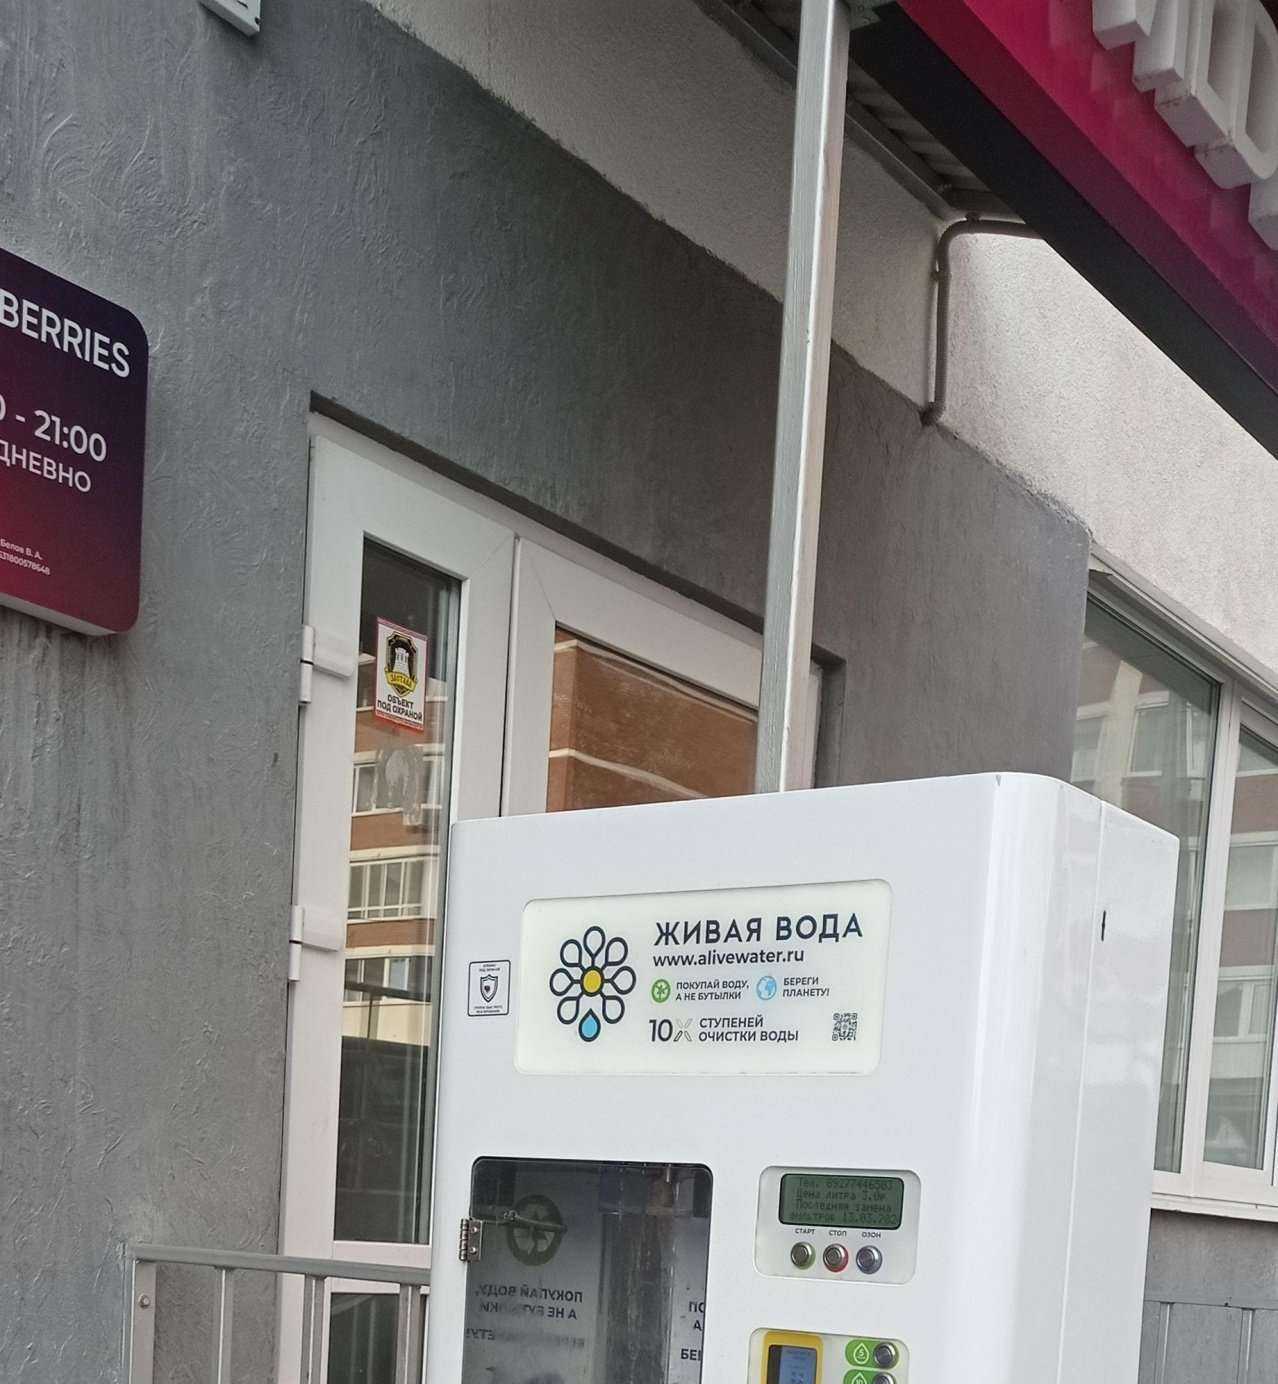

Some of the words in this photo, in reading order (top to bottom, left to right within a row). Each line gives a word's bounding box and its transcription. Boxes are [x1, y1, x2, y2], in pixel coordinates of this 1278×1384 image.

[0, 288, 130, 378] BERRIES
[34, 410, 107, 462] 21:00
[387, 694, 414, 709] ОБЪЕКТ
[377, 699, 392, 713] ПОД
[392, 705, 422, 720] ОХРАНОЙ
[654, 917, 762, 946] ЖИВАЯ
[775, 913, 863, 943] ВОДА
[653, 948, 804, 967] www.alivewater.ru
[676, 979, 720, 990] ПОКУПАЙ
[722, 979, 749, 989] ВОДУ,
[783, 977, 819, 986] БЕРЕГИ
[676, 993, 682, 1001] А
[684, 992, 696, 1001] НЕ
[698, 991, 742, 1000] БУТЫЛКИ
[782, 987, 830, 997] ПЛАНЕТУ!
[700, 1015, 763, 1028] СТУПЕНЕЙ
[699, 1030, 756, 1042] ОЧИСТКИ
[760, 1030, 799, 1043] ВОДЫ
[828, 1229, 847, 1237] СТОП
